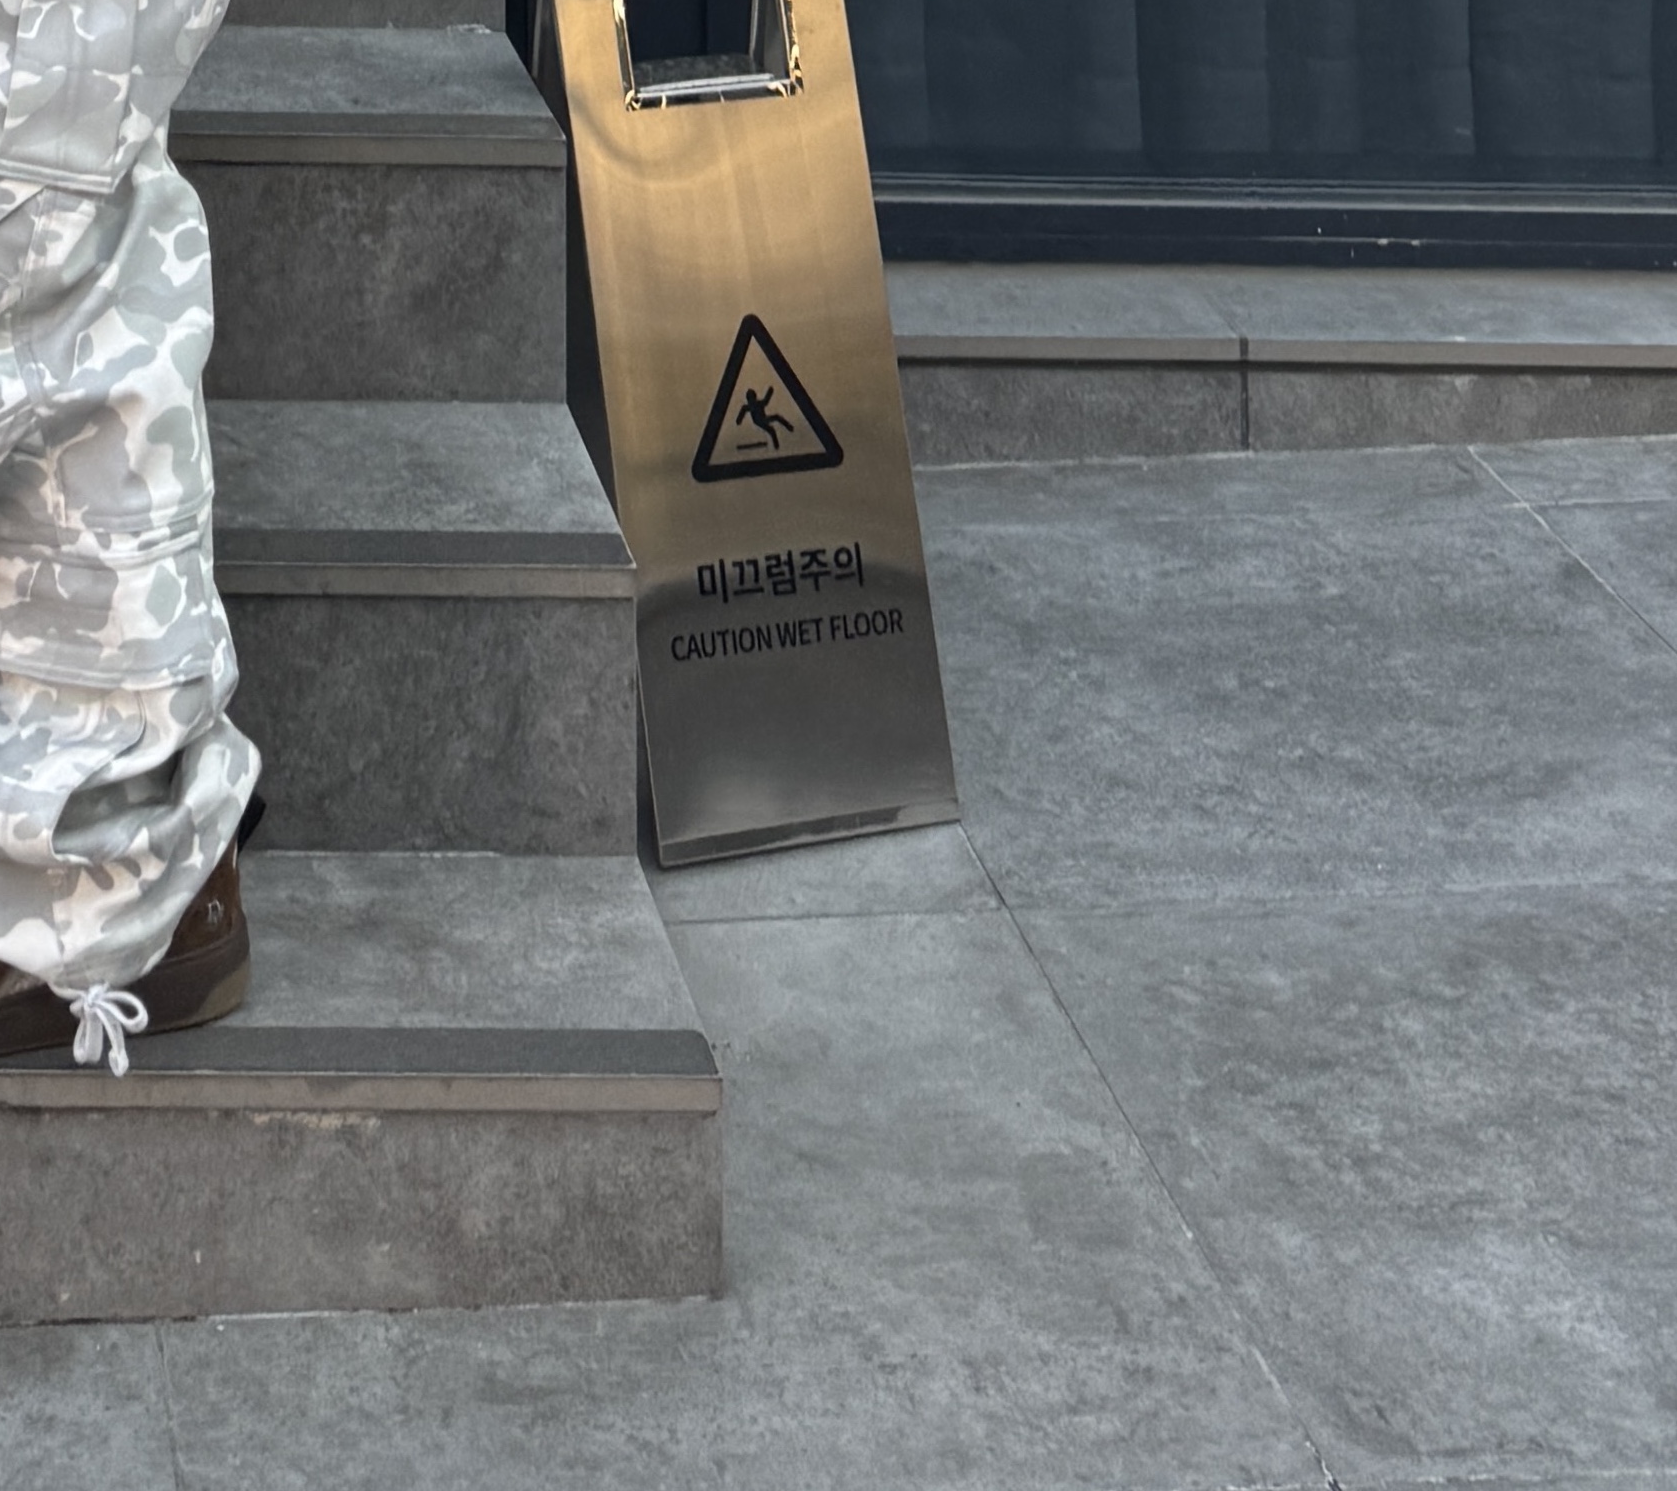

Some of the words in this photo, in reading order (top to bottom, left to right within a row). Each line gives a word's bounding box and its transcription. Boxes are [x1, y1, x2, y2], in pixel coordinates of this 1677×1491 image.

[696, 542, 865, 604] 미끄럼주의
[670, 623, 774, 662] CAUTION
[775, 617, 824, 650] WET
[829, 608, 904, 640] FLOOR
